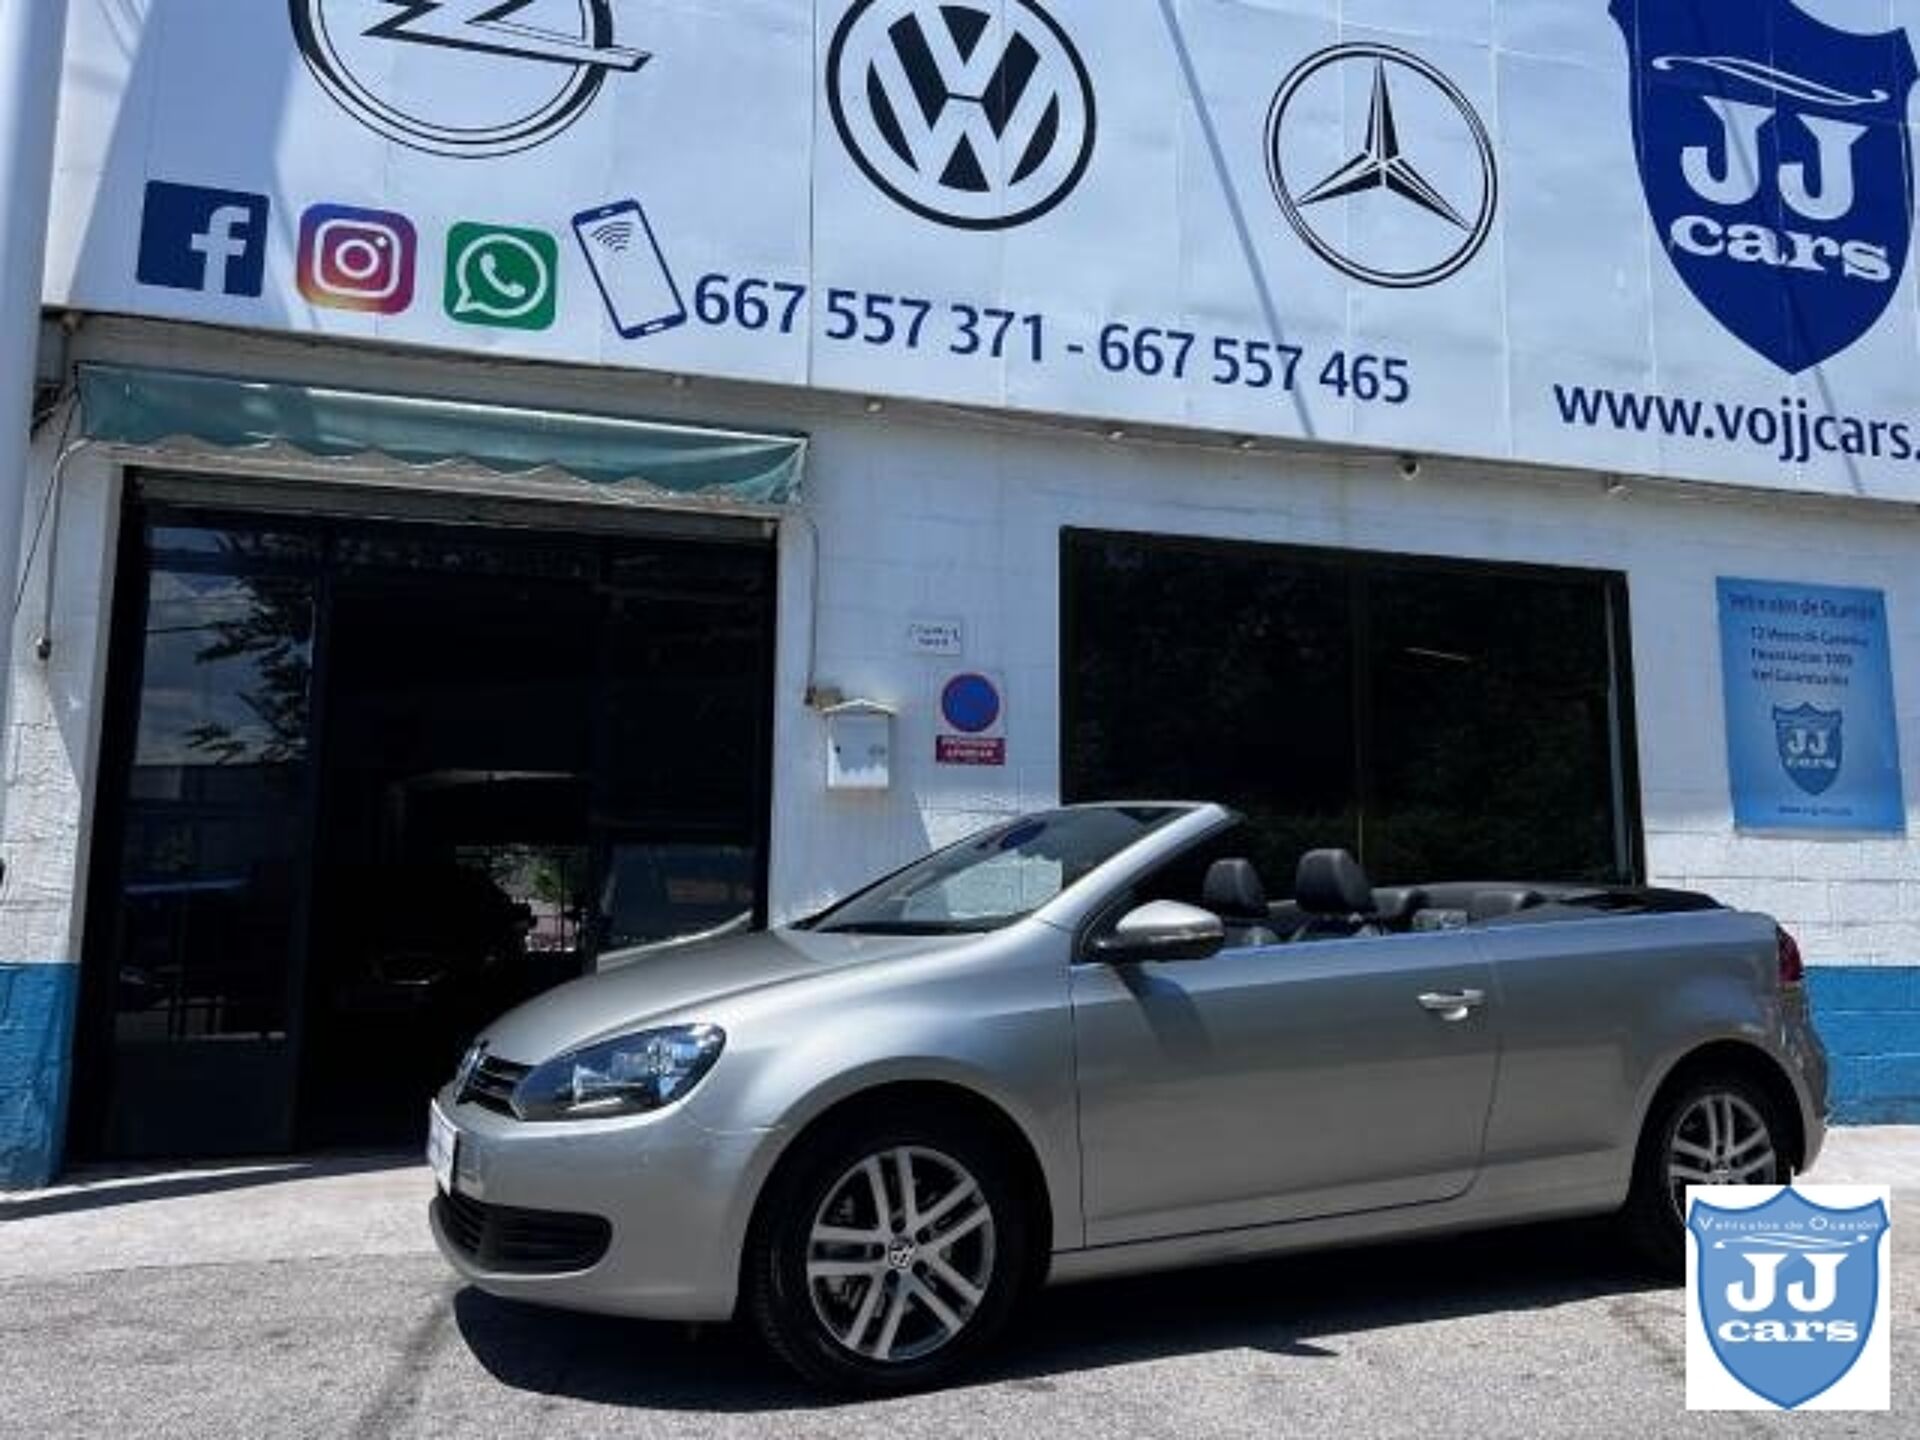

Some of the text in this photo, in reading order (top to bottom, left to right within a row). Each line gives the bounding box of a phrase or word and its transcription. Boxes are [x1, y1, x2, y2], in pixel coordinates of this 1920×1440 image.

[1680, 96, 1869, 221] JJ
[1669, 214, 1891, 282] cars
[695, 273, 806, 333] 667
[825, 288, 932, 348] 557
[949, 304, 1043, 362] 371
[1099, 323, 1195, 378] 667
[1212, 337, 1303, 391] 557
[1319, 350, 1409, 404] 465
[1787, 729, 1830, 756] JJ
